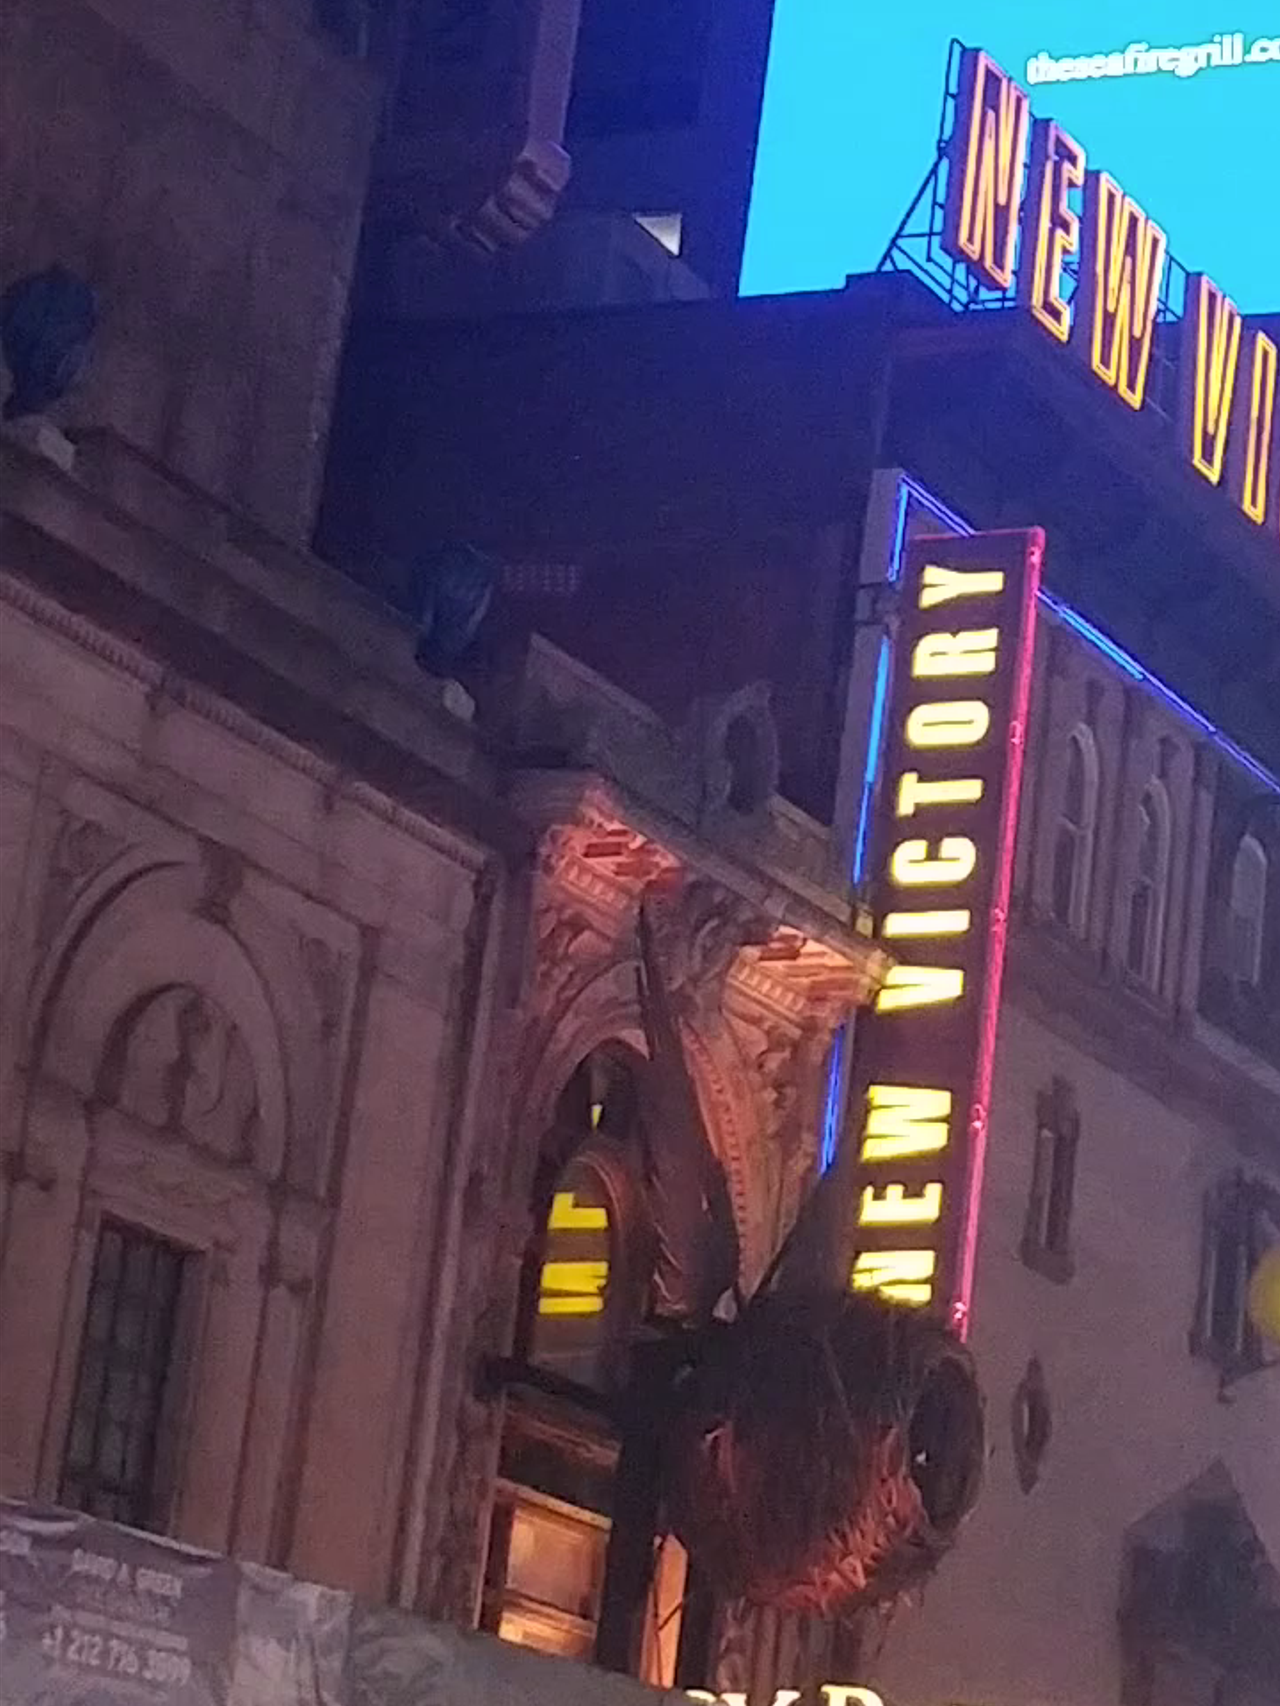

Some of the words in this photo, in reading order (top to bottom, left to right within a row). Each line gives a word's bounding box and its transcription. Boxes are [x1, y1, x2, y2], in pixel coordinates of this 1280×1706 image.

[958, 48, 1168, 411] NEW
[875, 564, 1005, 1015] VICTORY
[849, 1083, 953, 1307] NEW
